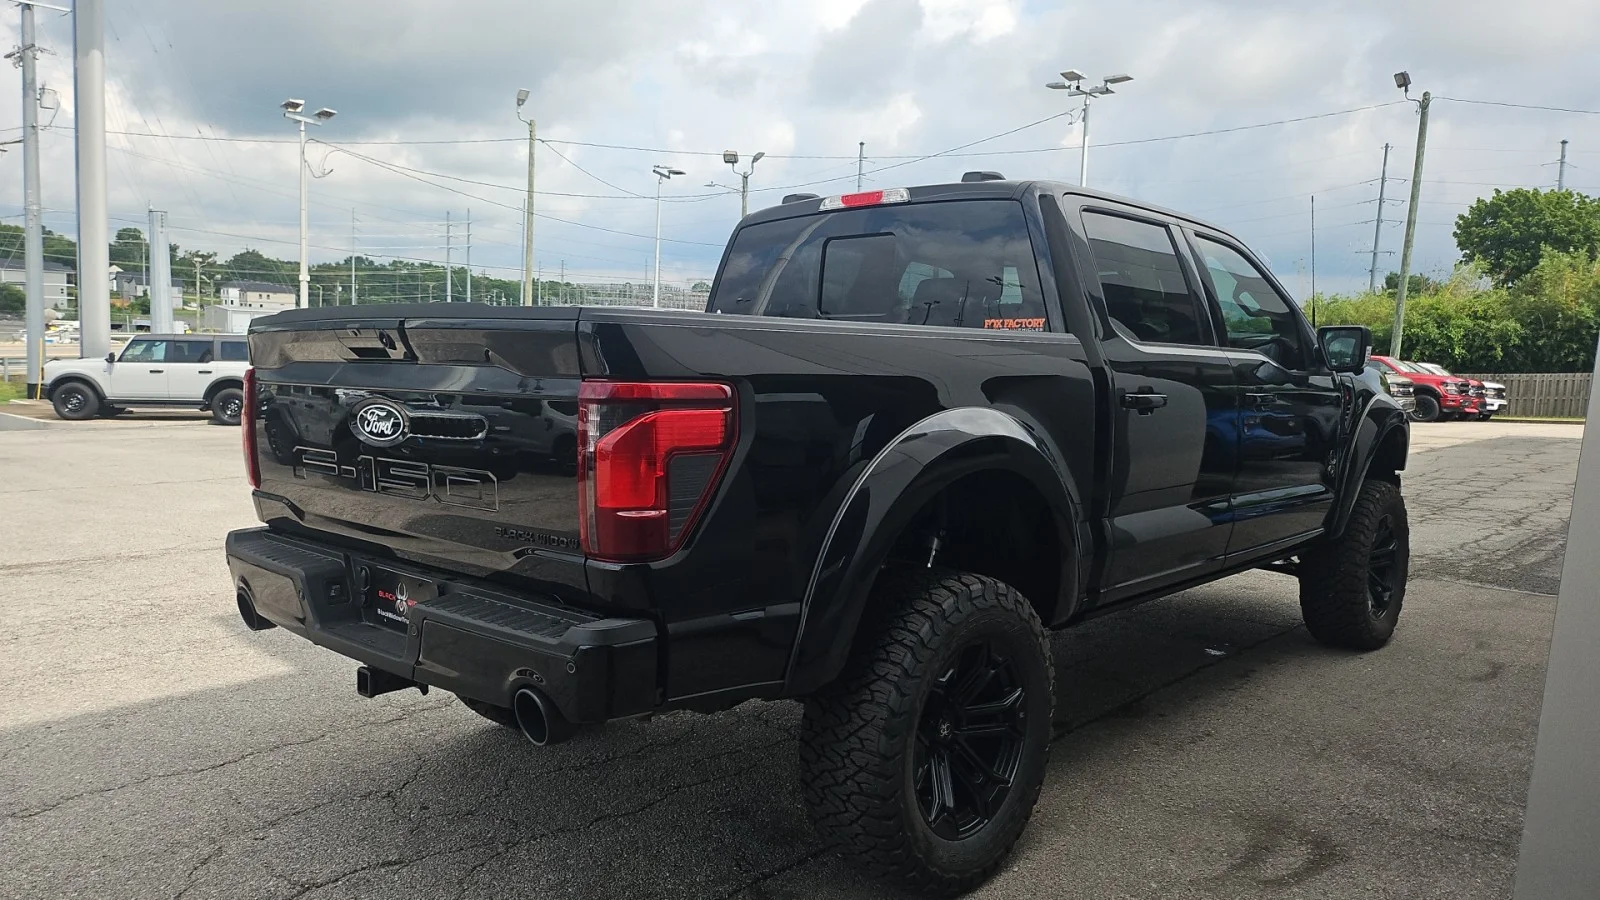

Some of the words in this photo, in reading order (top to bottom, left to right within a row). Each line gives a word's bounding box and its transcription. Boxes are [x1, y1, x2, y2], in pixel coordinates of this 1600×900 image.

[984, 319, 1003, 328] FOX
[1004, 318, 1045, 328] FACTORY
[364, 408, 395, 435] Ford
[293, 446, 499, 513] F-150
[494, 526, 535, 543] BLACK
[537, 533, 580, 549] WIDOW
[378, 590, 396, 601] BLACK
